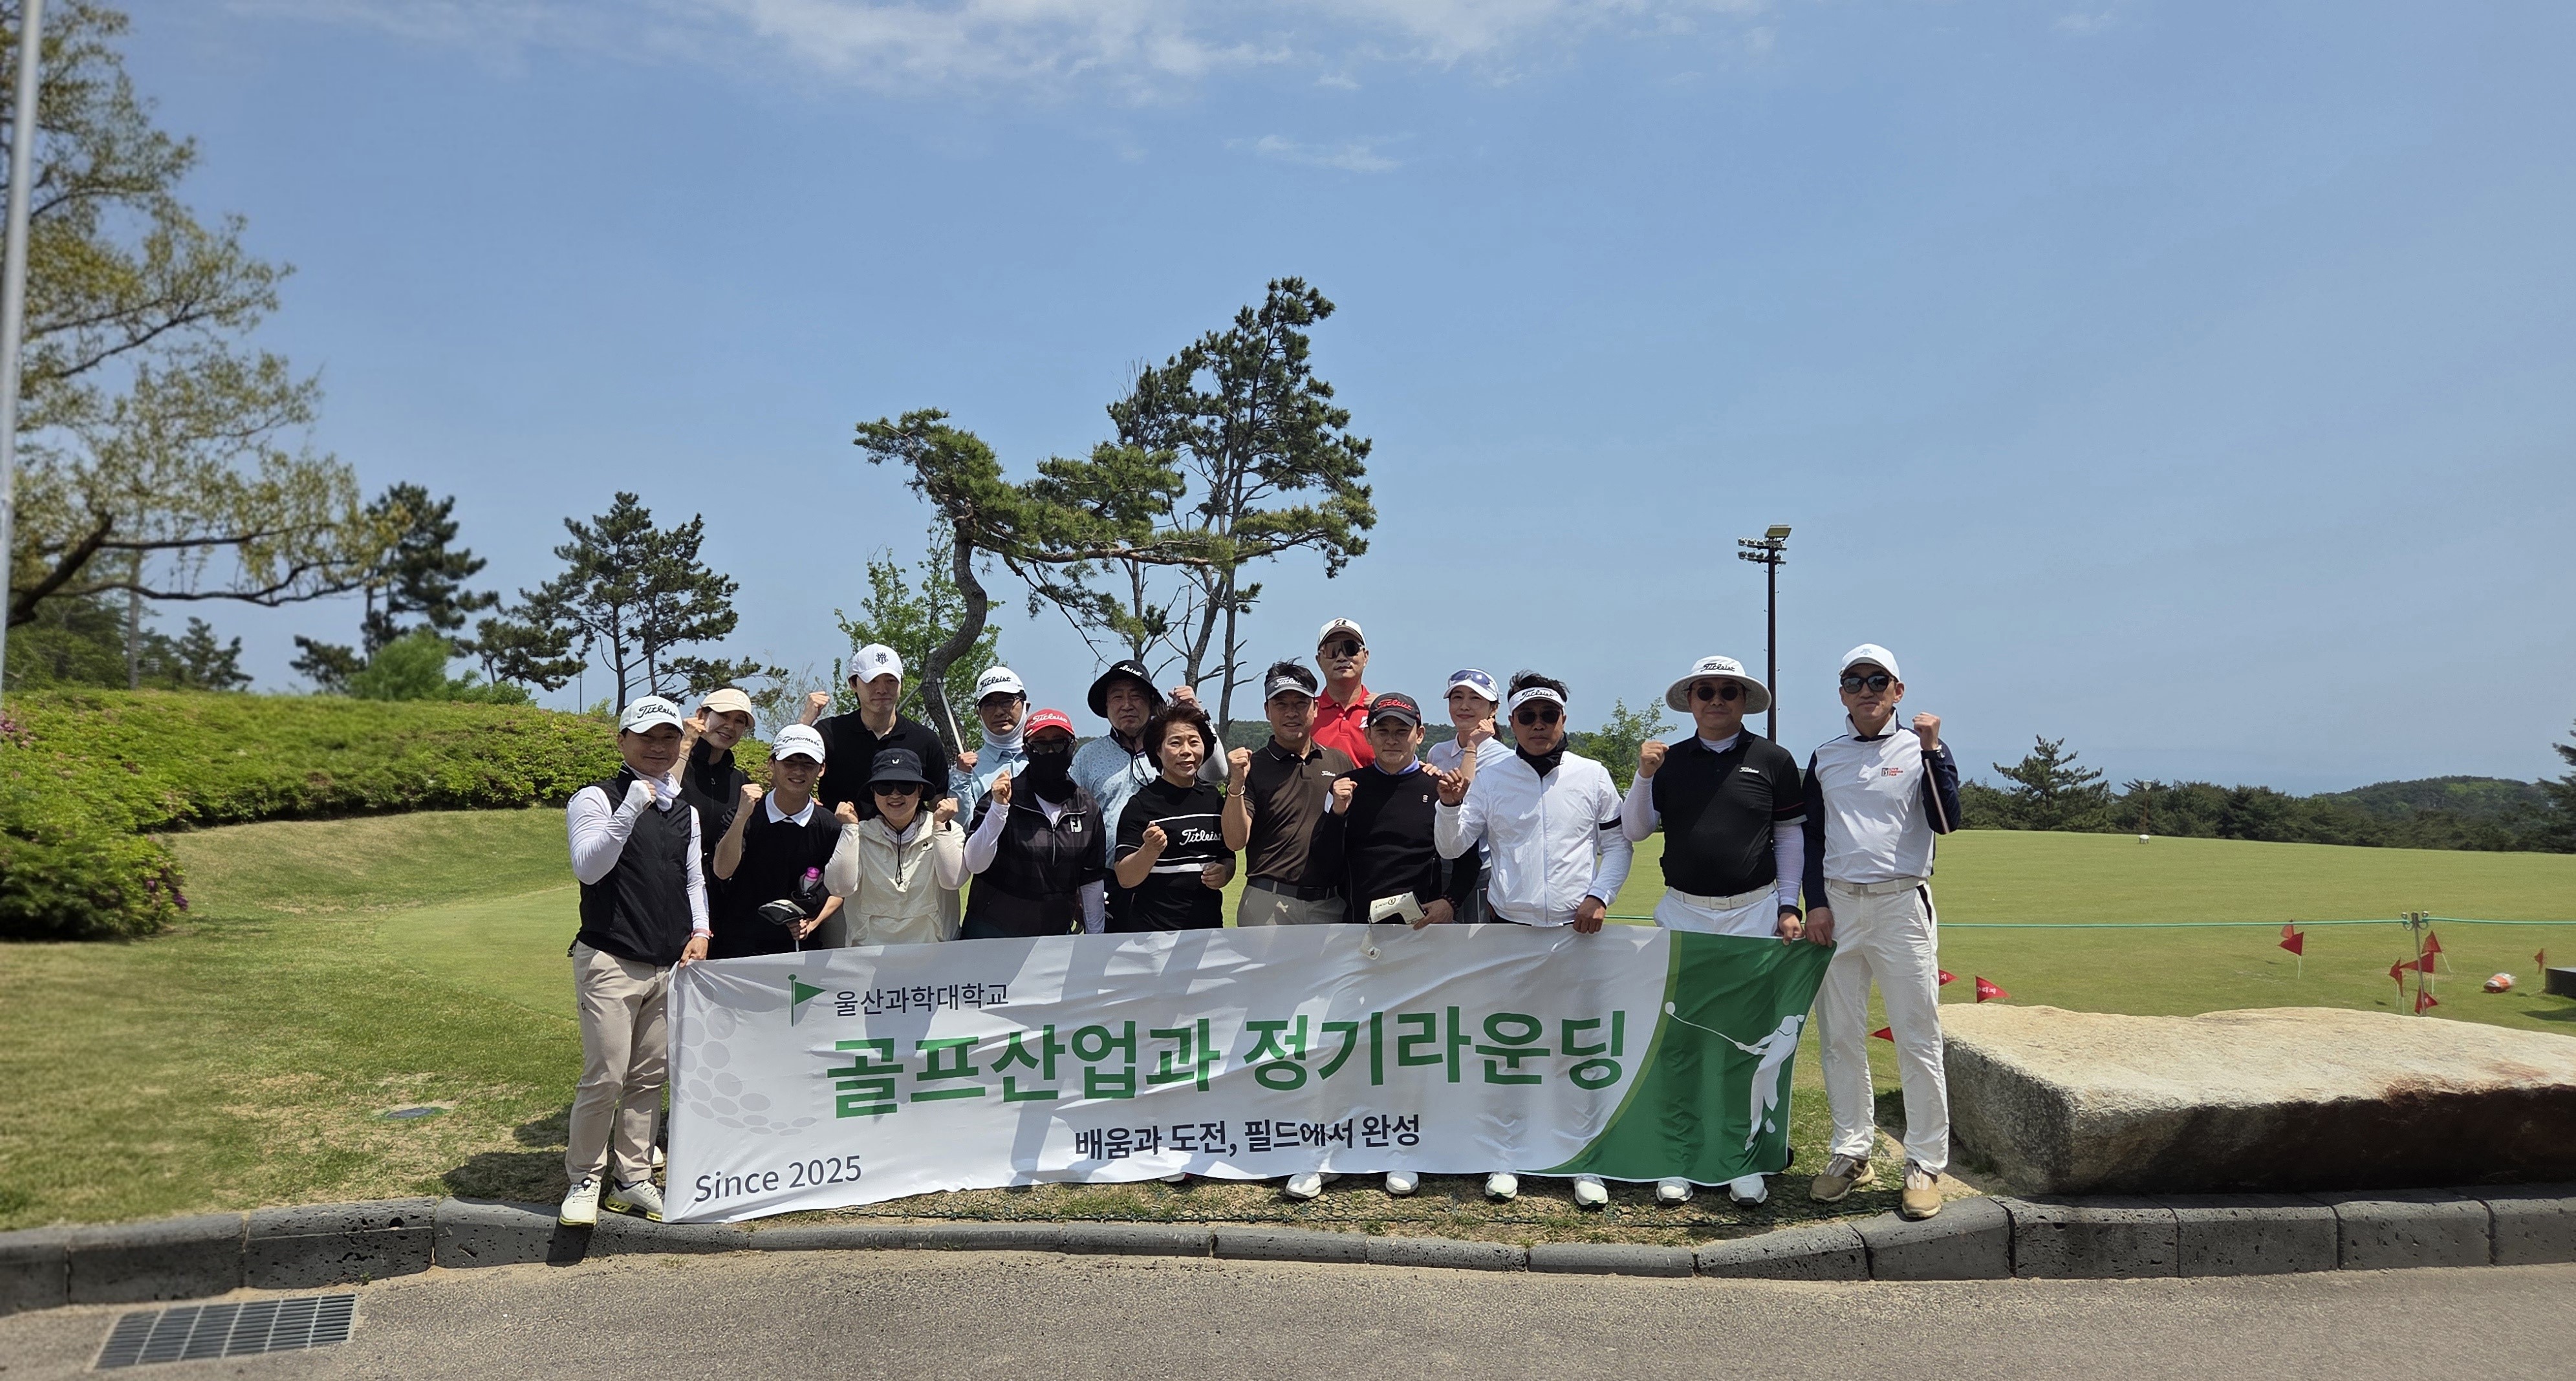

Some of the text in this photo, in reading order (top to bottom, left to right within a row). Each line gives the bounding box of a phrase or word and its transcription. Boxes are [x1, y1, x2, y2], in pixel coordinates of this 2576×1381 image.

[979, 676, 1012, 692] Titleist
[637, 703, 677, 719] Titleist
[782, 736, 819, 747] TaylorMade
[1179, 828, 1222, 846] Titleist
[833, 982, 1009, 1018] 울산과학대학교
[827, 1006, 1624, 1120] 골프산업과 정기라운딩
[1074, 1113, 1420, 1161] 배움과 도전, 필드에서 완성
[694, 1155, 861, 1203] Since 2025
